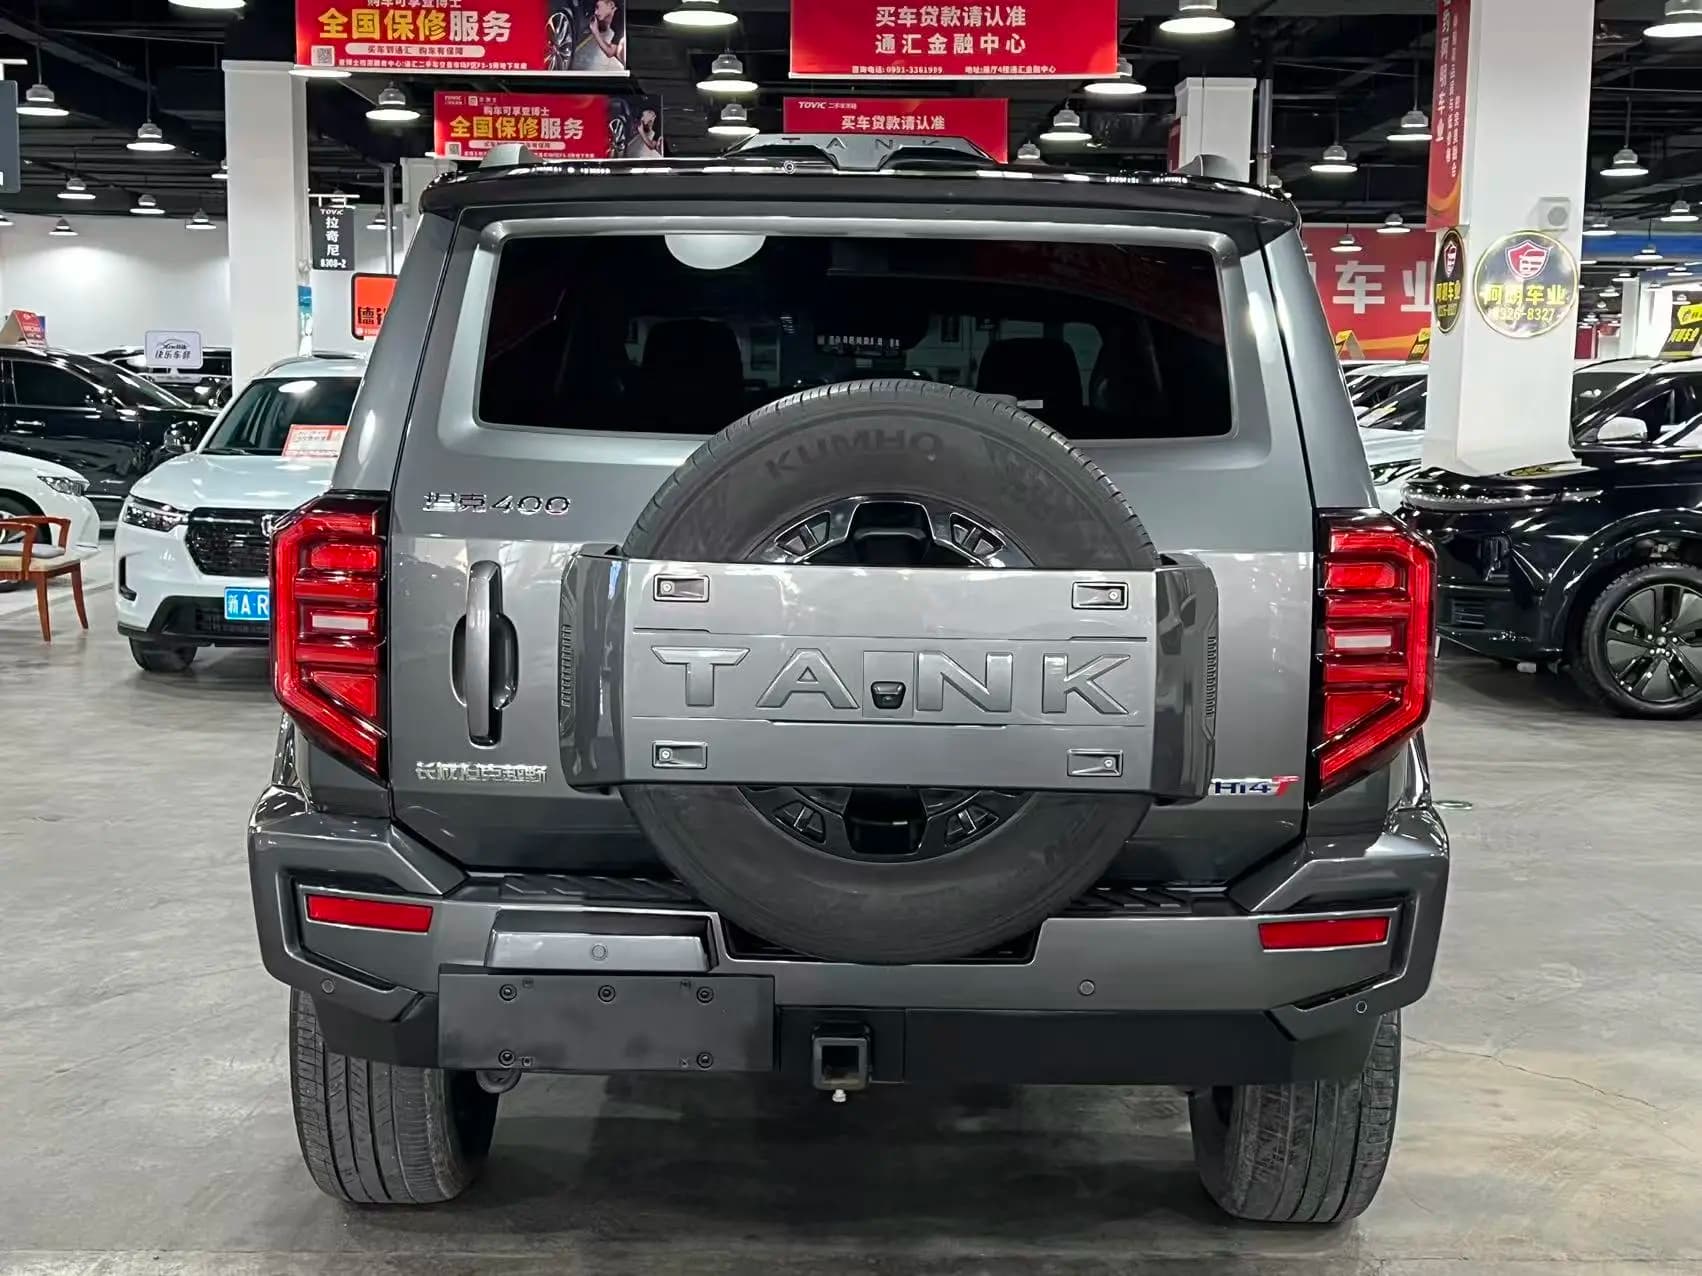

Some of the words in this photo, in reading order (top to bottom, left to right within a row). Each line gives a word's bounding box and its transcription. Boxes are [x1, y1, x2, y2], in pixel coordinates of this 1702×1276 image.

[317, 8, 512, 42] 全国保修服务
[875, 6, 1027, 28] 买车贷款请认准
[875, 33, 1026, 55] 通汇金融中心
[450, 115, 584, 139] 全国保修服务
[841, 115, 945, 131] 买车贷款请认准
[325, 216, 341, 257] 拉奇尼
[1309, 260, 1433, 314] 车业
[764, 429, 943, 479] KUMHO
[422, 491, 571, 516] 坦克400
[651, 645, 1131, 715] TANK
